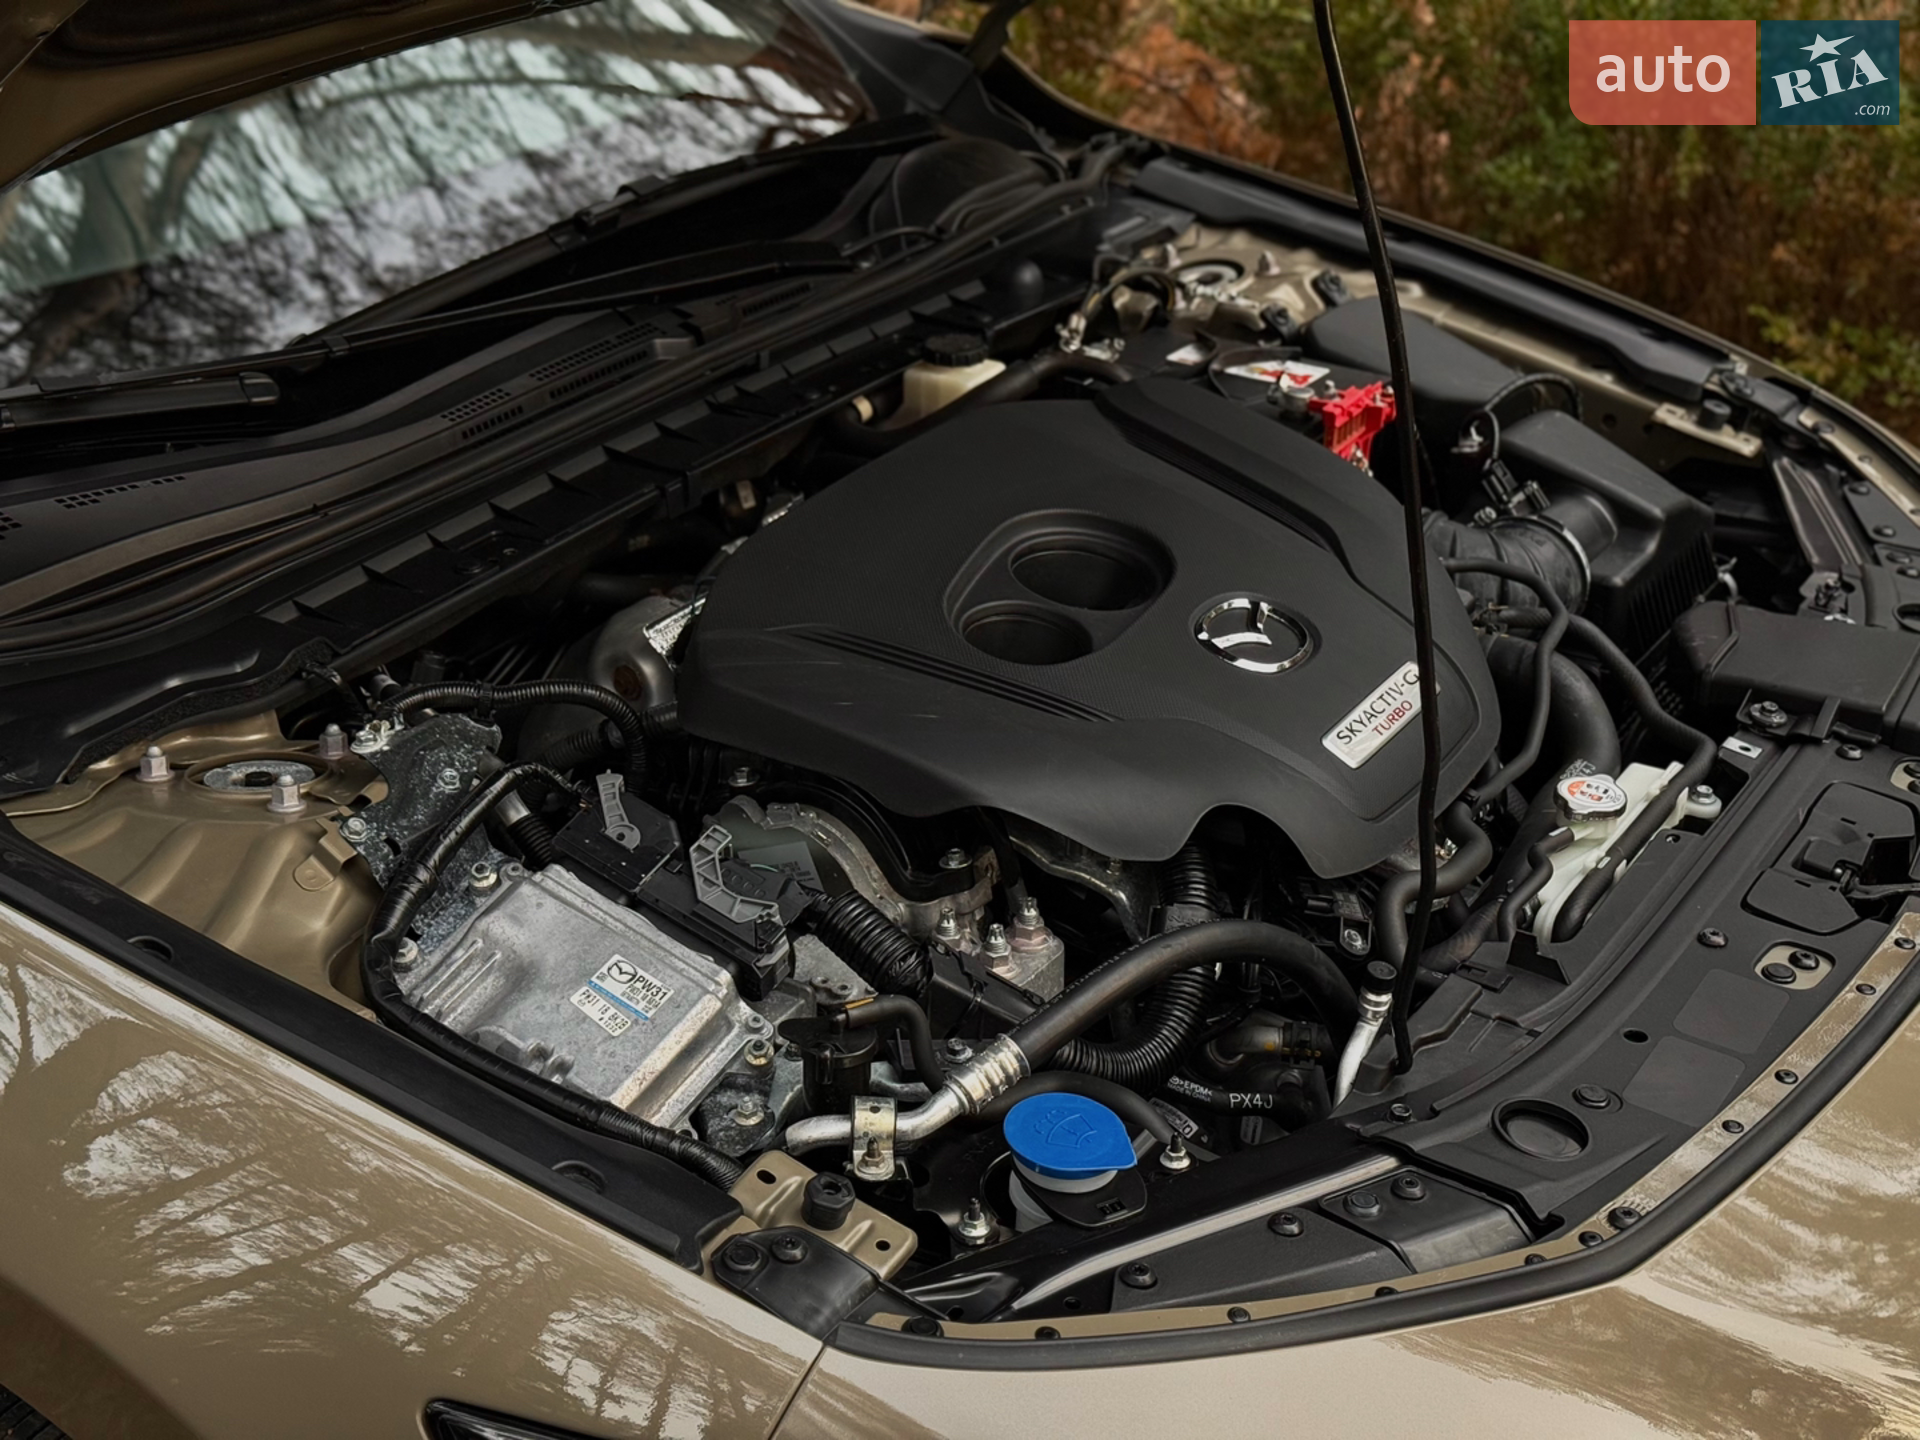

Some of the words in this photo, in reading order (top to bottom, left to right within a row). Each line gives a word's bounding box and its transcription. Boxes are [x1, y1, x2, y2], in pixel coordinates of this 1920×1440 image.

[1336, 669, 1420, 745] SKYACTIV-G
[1371, 700, 1413, 737] TURBO
[633, 975, 668, 1001] PW31
[1228, 1092, 1274, 1109] PX4J
